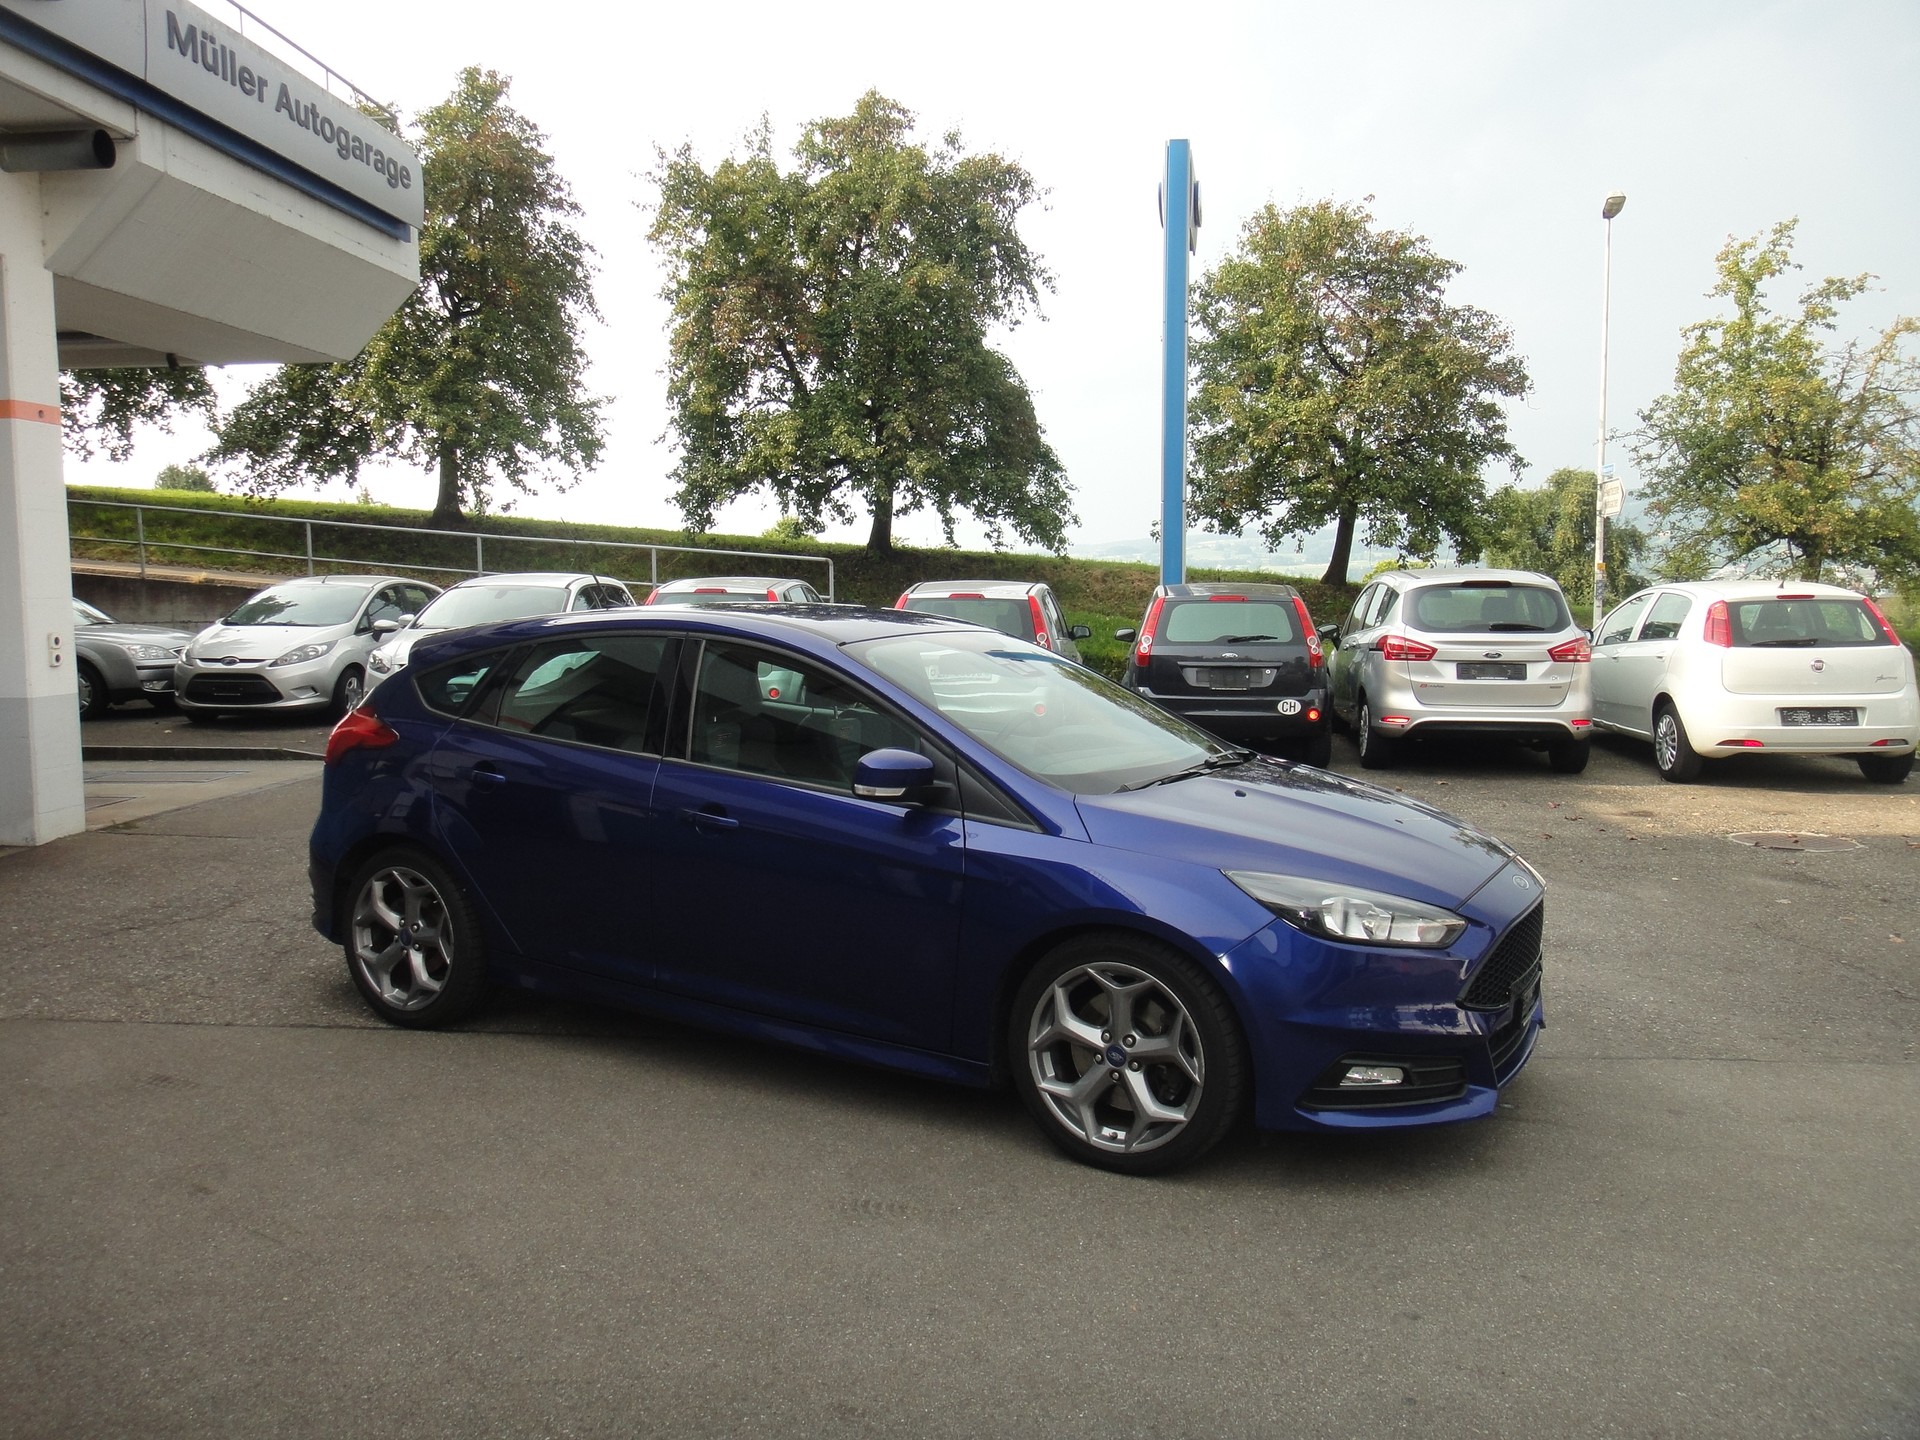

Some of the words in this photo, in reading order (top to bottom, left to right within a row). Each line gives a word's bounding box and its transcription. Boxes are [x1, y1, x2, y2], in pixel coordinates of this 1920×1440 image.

[166, 10, 268, 102] Müller
[275, 83, 412, 189] Autogarage
[1281, 701, 1296, 713] CH
